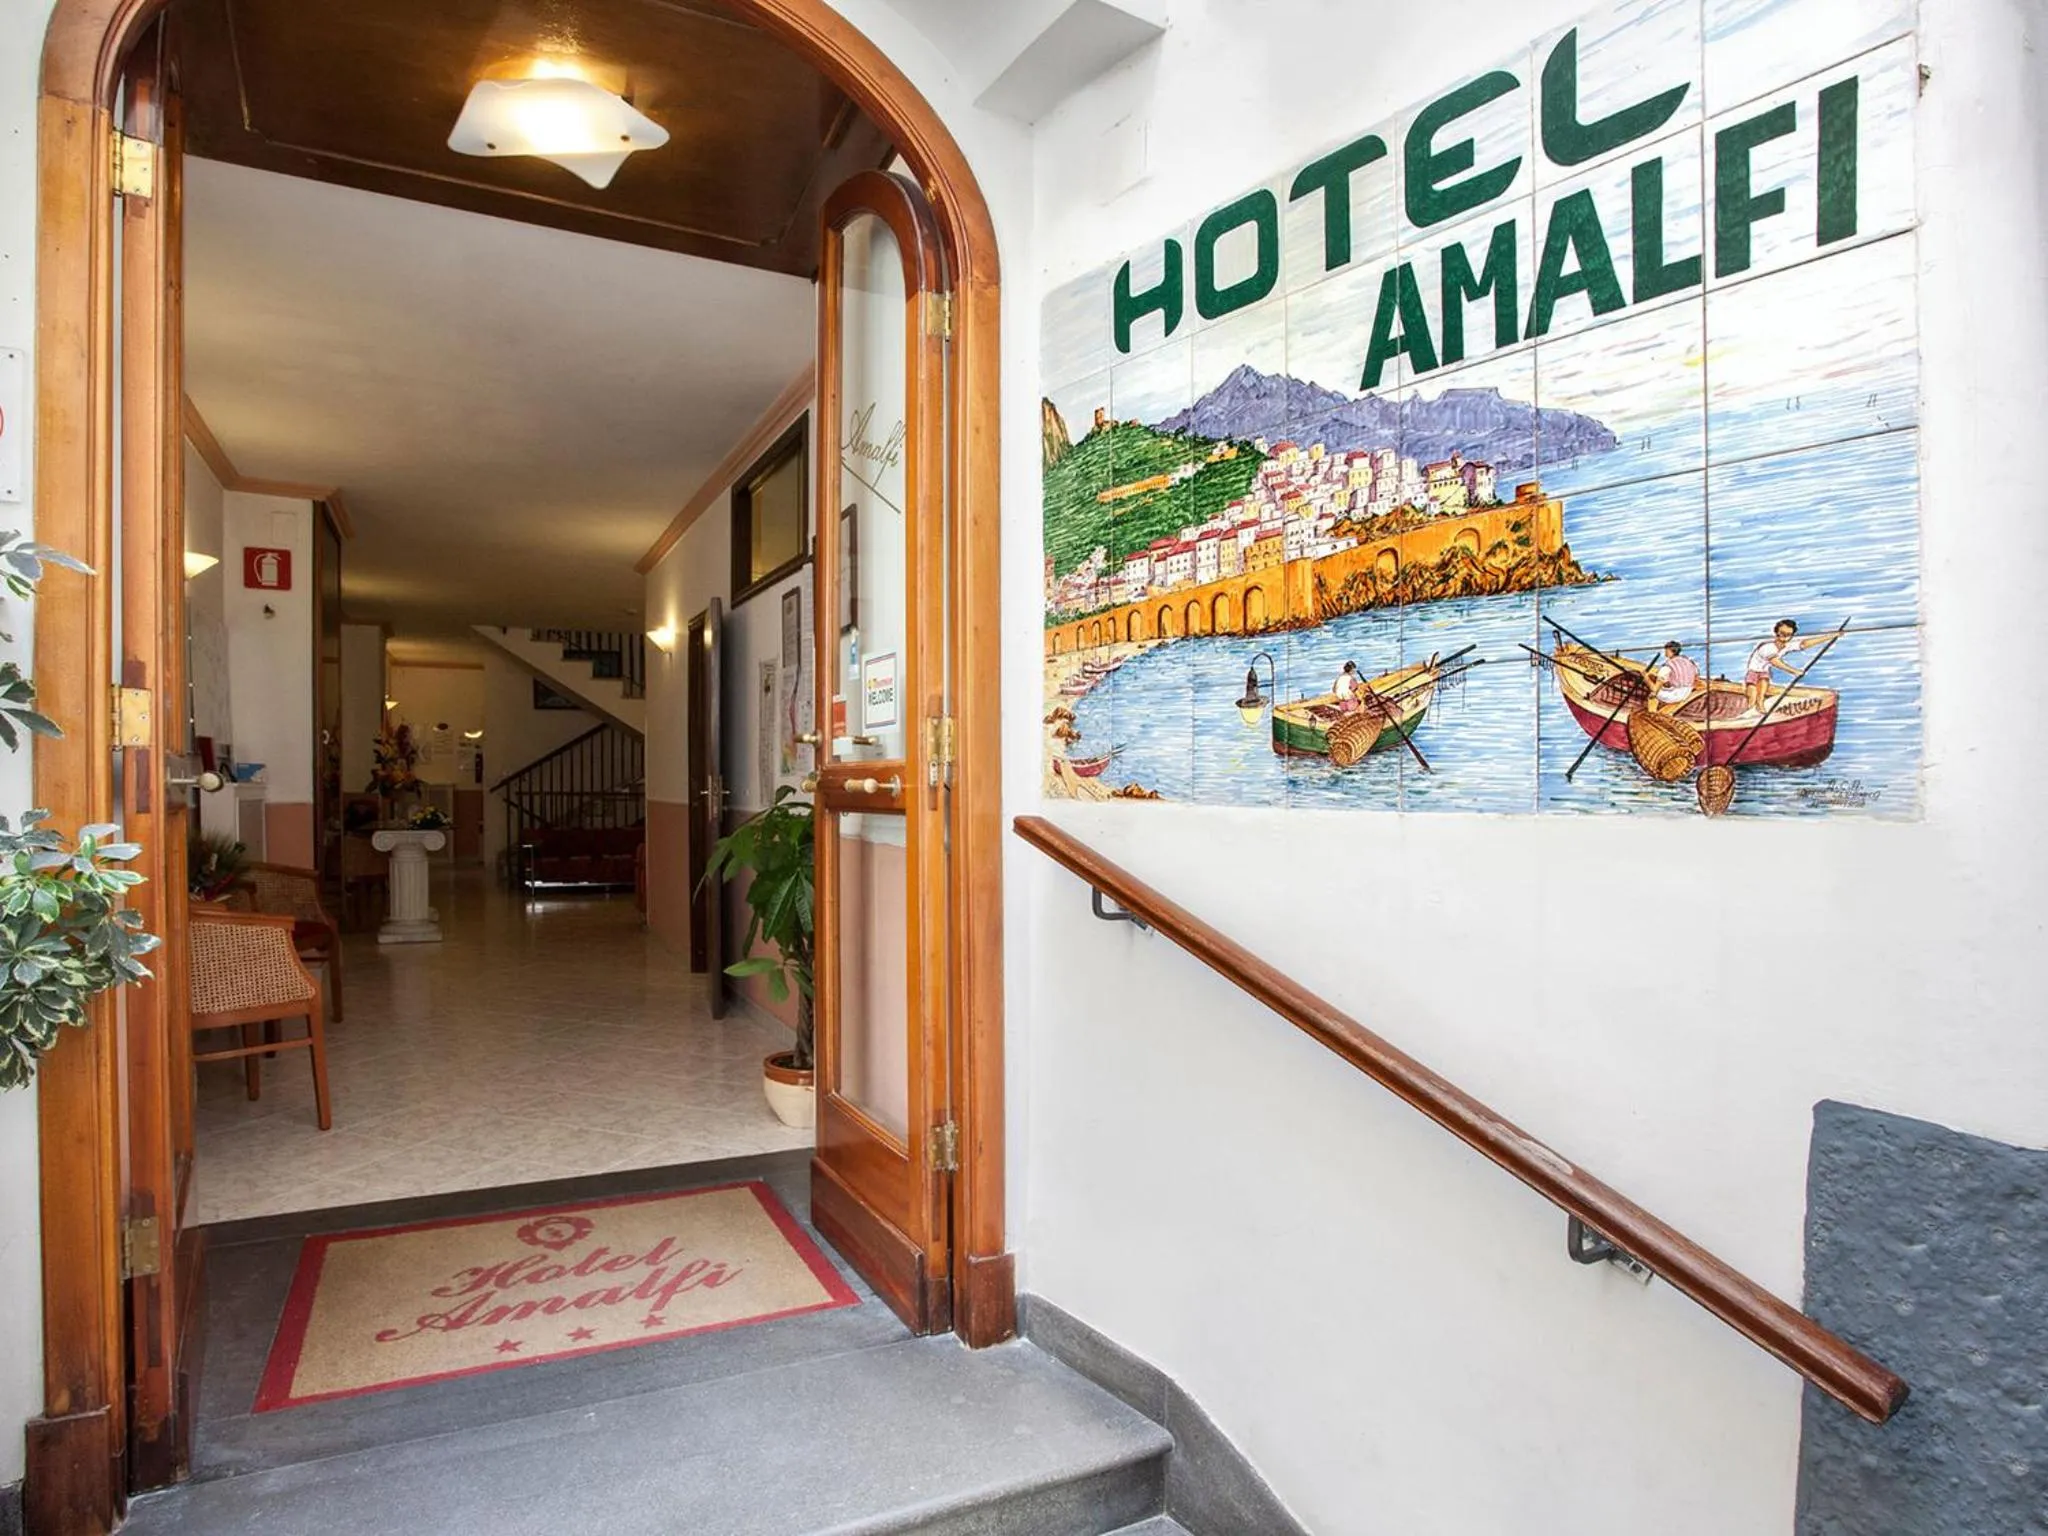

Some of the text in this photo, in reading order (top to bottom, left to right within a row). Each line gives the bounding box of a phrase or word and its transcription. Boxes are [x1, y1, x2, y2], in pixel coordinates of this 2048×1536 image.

[1114, 29, 1690, 354] HOTEL
[1360, 75, 1858, 391] AMALFI
[841, 402, 906, 488] Amalfi
[868, 687, 893, 706] WELCOME
[375, 1258, 743, 1342] Amalfi
[430, 1236, 684, 1299] Hotel
